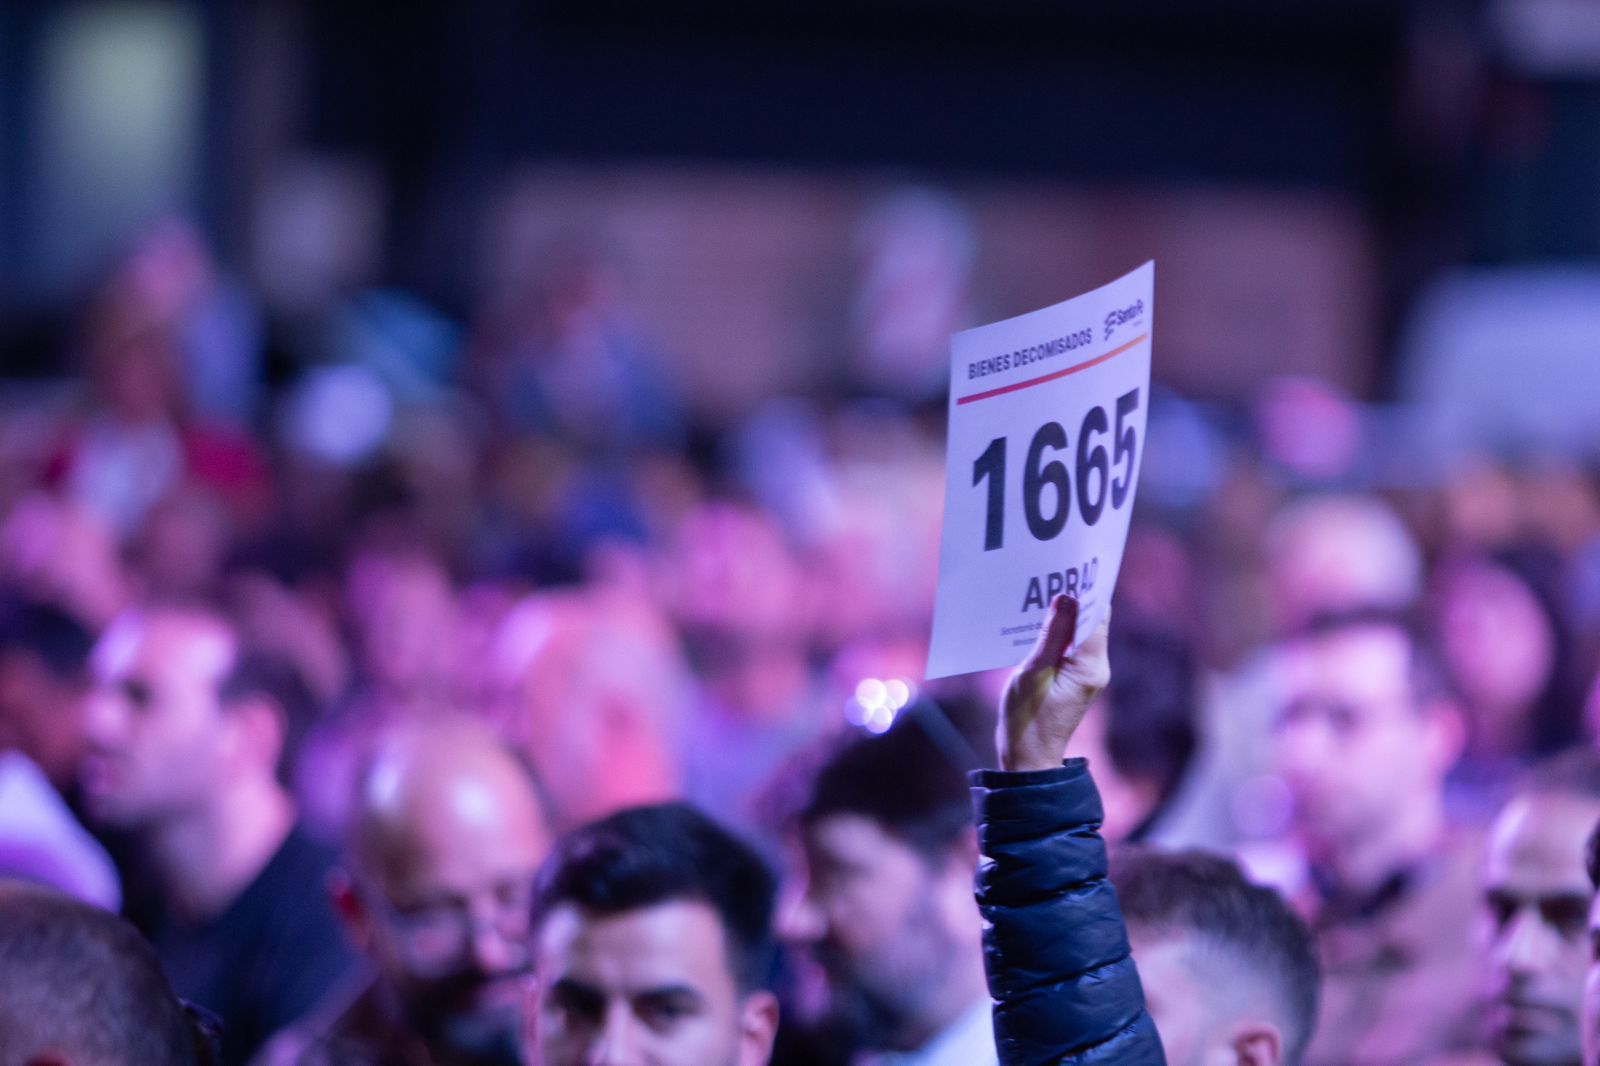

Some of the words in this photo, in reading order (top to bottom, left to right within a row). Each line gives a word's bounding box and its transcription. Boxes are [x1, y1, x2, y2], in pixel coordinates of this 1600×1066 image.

[968, 353, 1010, 379] BIENES
[1013, 327, 1092, 368] DECOMISADOS
[972, 386, 1140, 552] 1665
